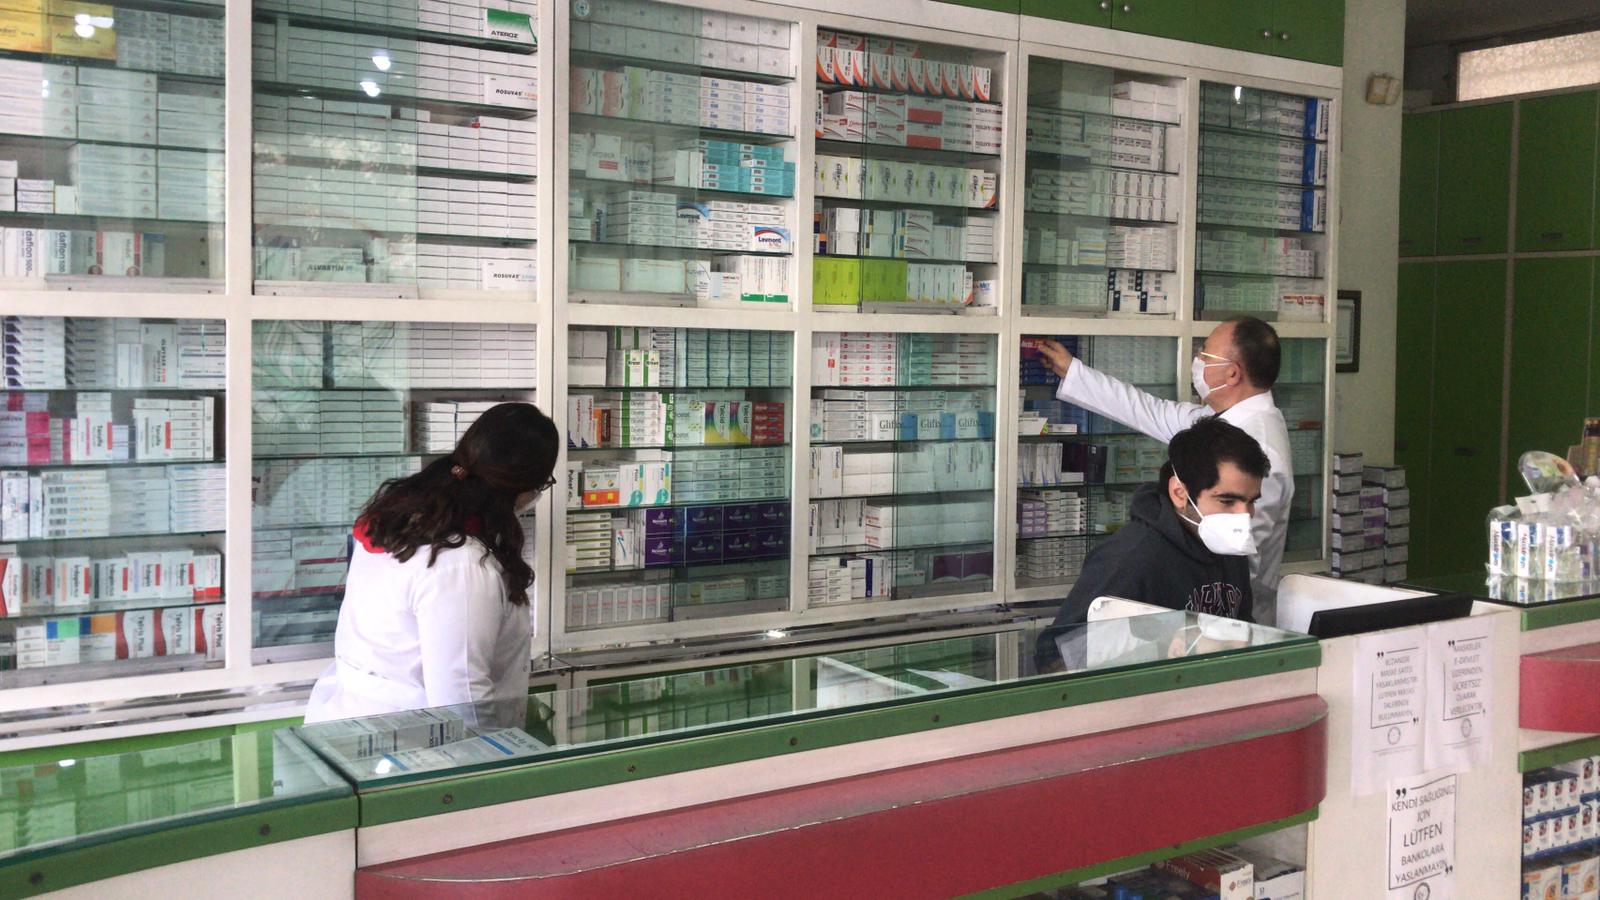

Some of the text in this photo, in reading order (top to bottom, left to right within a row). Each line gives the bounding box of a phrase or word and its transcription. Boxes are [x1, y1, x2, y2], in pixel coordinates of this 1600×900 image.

[491, 30, 519, 39] ATEROZ
[495, 89, 521, 97] ROSUVAS
[25, 230, 34, 271] daflon 500
[59, 231, 67, 261] daflon
[1391, 798, 1418, 812] KENDİ
[1417, 809, 1431, 823] İÇİN
[1403, 822, 1443, 847] LÜTFEN
[1401, 843, 1445, 866] BANKOLARA
